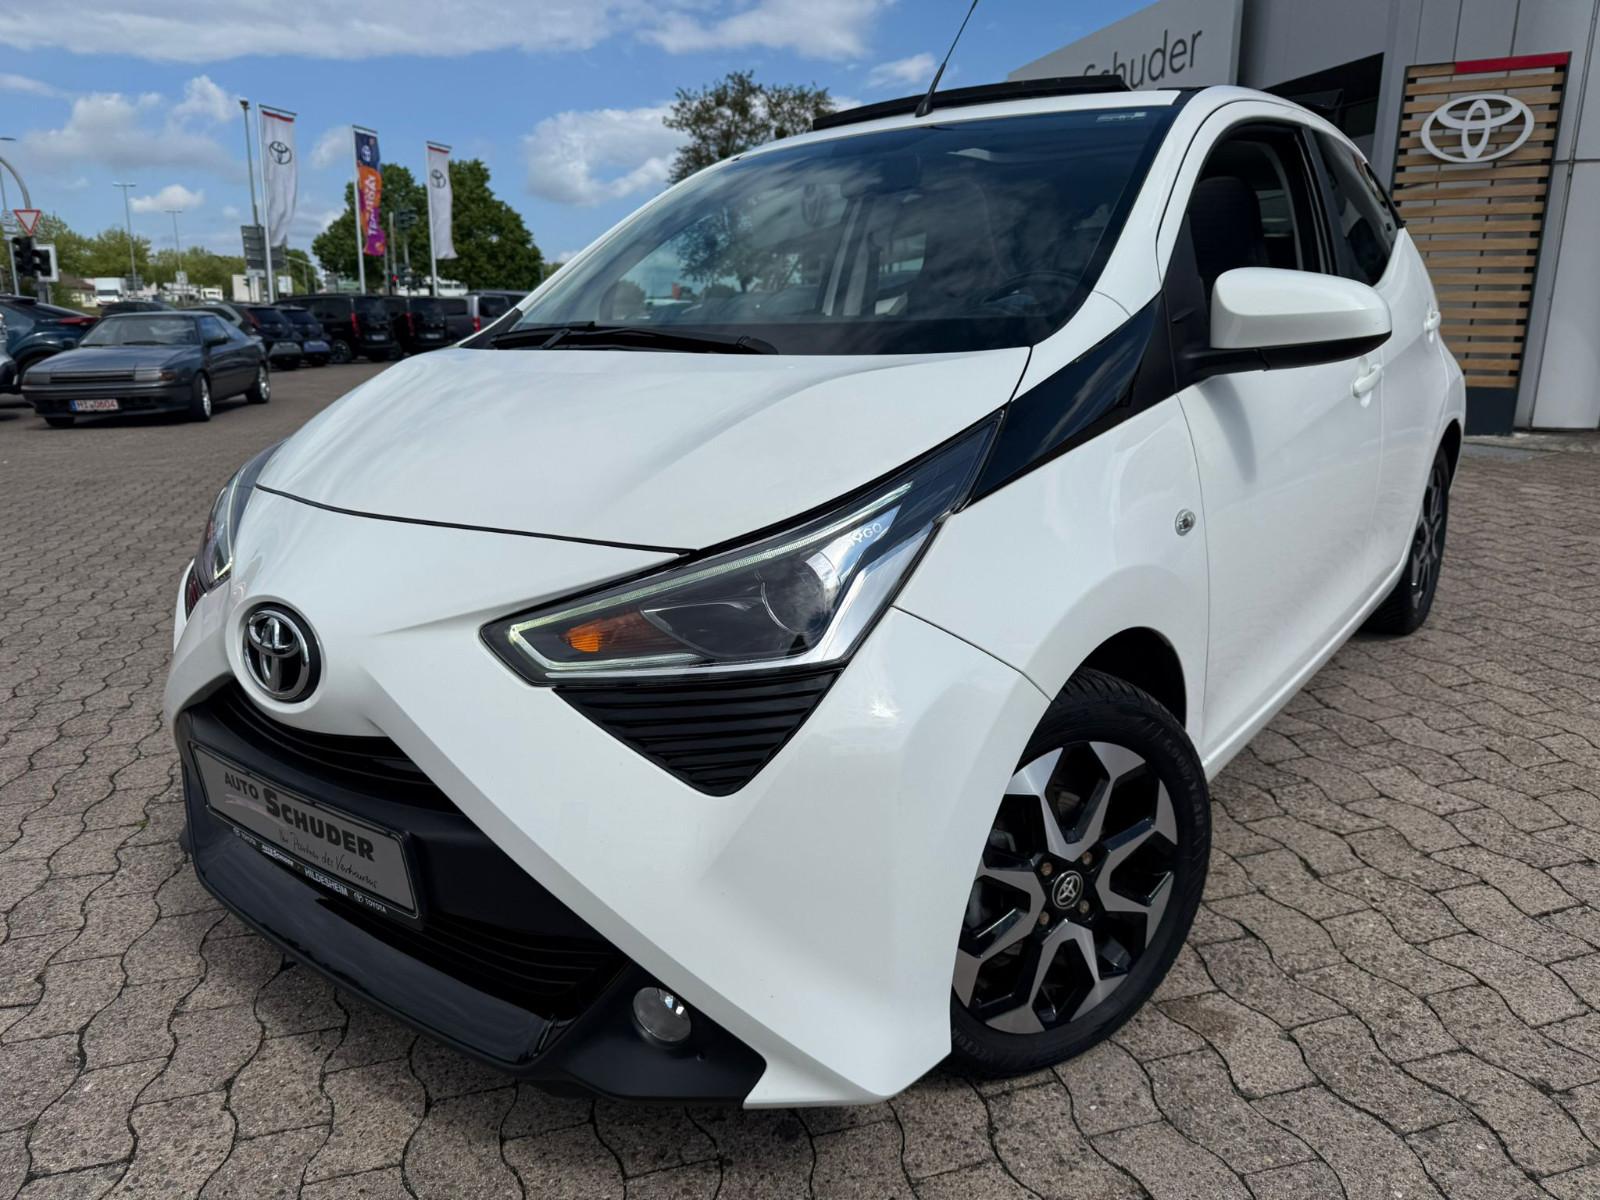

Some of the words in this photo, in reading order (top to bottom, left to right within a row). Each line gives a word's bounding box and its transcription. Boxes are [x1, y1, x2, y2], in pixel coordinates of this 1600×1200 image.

[1084, 29, 1202, 89] huder
[224, 771, 259, 800] AUTO
[263, 787, 375, 863] SCHUDER
[304, 865, 349, 897] HILDESHEIM
[364, 898, 387, 913] TOYOTA
